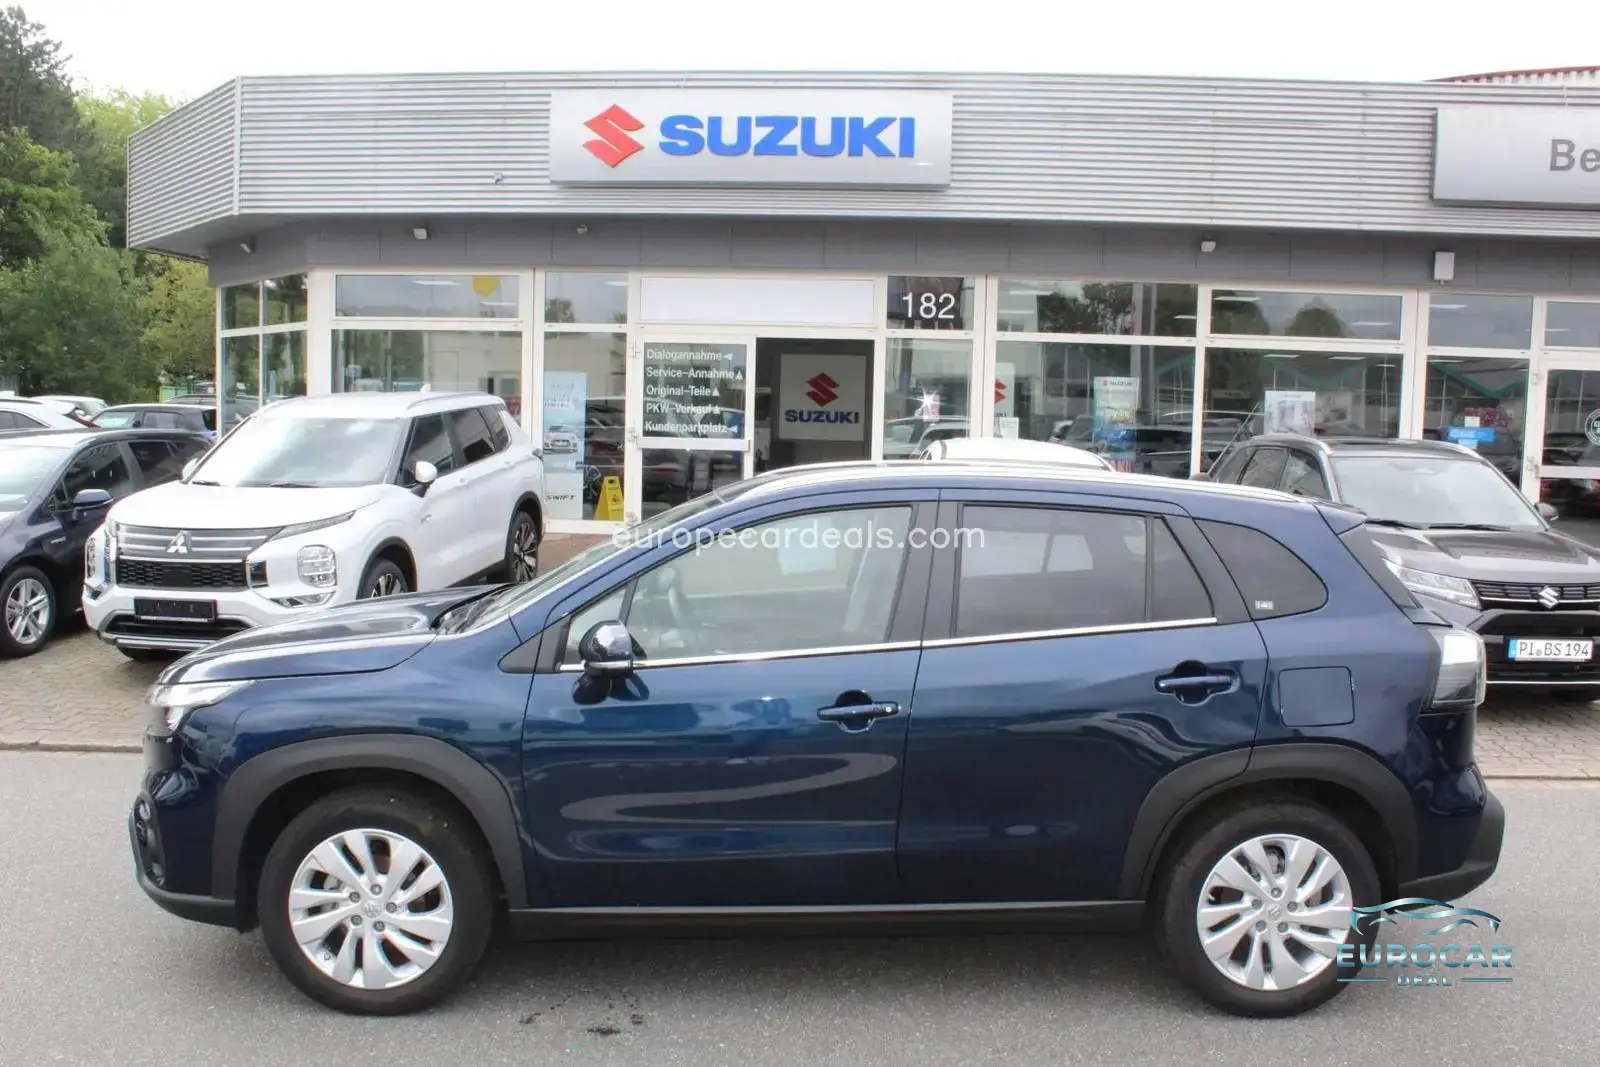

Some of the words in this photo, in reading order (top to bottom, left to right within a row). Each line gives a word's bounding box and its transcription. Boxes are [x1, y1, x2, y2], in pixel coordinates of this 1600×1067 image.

[659, 114, 915, 158] SUZUKI
[1550, 138, 1600, 173] Be
[902, 292, 955, 319] 182
[646, 349, 722, 361] Dialogannahme
[646, 367, 734, 378] Service-Annahme
[646, 385, 711, 397] Original-Teile
[646, 403, 712, 414] PKW-Verkauf
[784, 409, 859, 424] SUZUKI
[644, 421, 727, 436] Kundenparkplatz
[1565, 643, 1589, 656] 194
